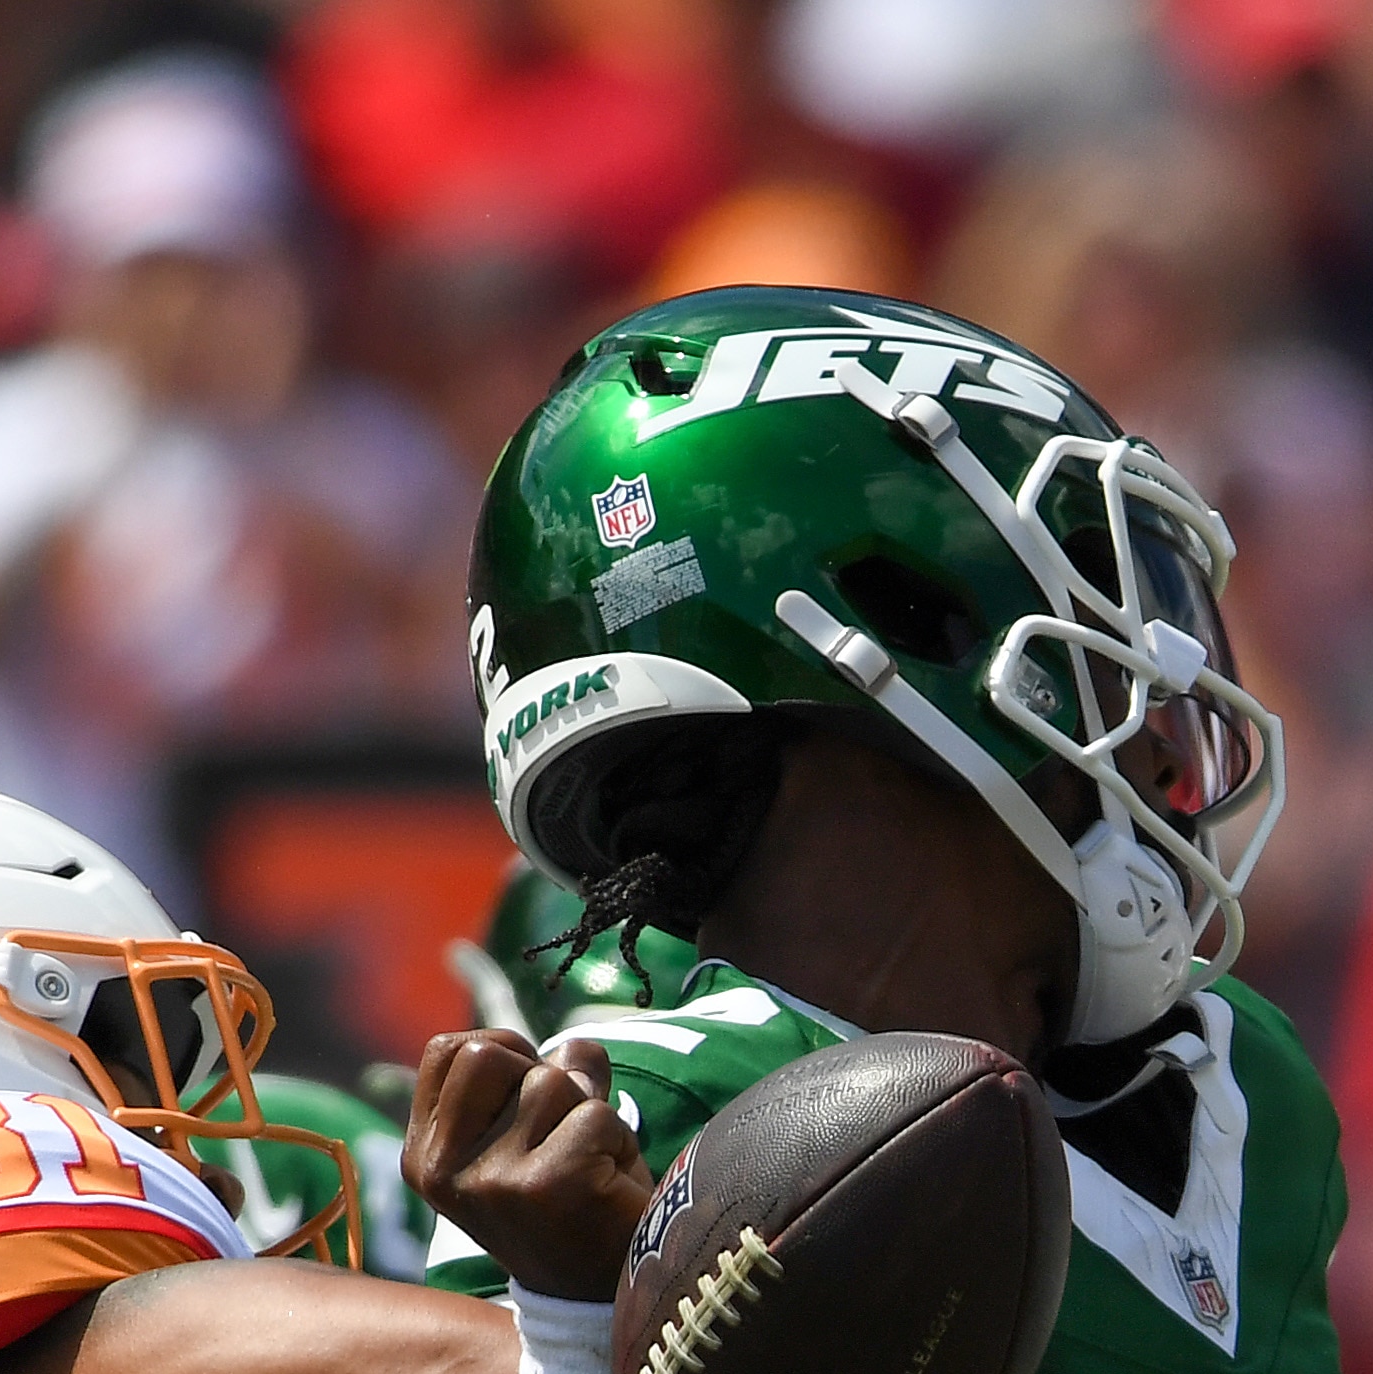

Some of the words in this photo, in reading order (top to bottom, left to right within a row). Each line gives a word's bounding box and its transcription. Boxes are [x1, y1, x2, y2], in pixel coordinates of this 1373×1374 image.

[635, 306, 1070, 444] JETS
[605, 502, 646, 537] NFL
[496, 663, 613, 761] YORK
